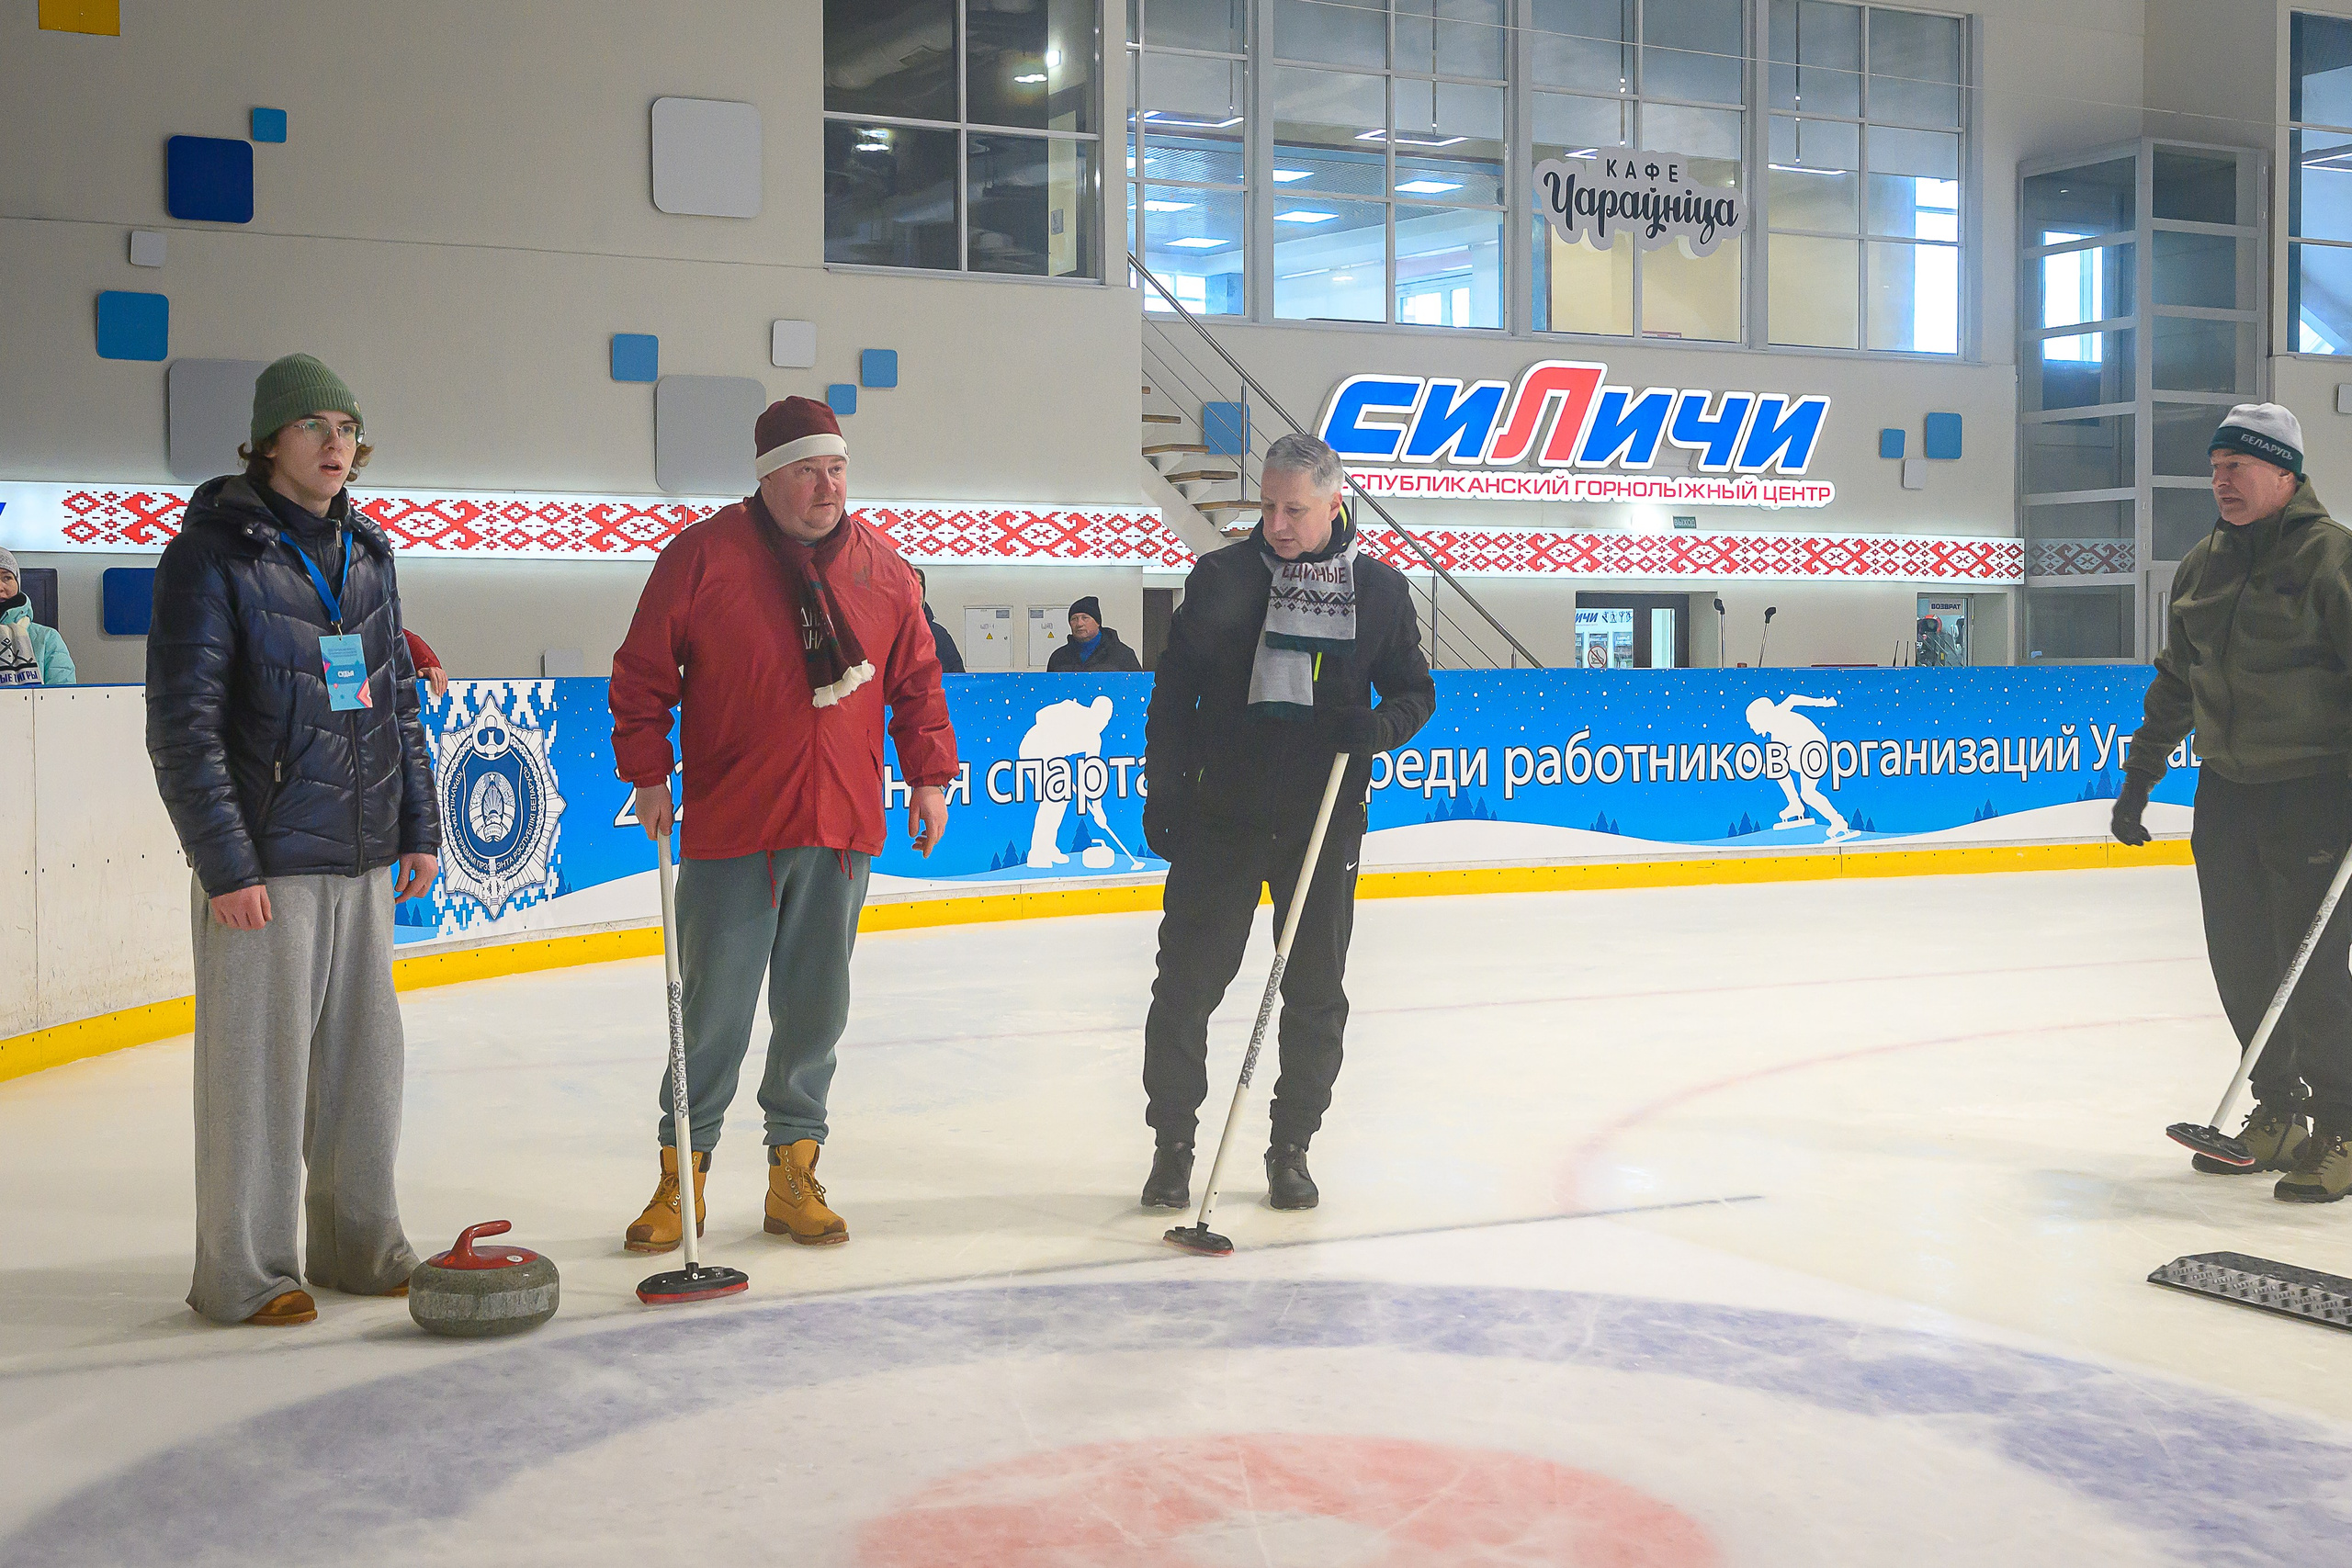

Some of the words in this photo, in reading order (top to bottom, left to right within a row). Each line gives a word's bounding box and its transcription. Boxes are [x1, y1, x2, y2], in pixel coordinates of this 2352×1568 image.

[1606, 158, 1679, 183] КАФЕ
[1543, 171, 1739, 245] Чараўніца
[2240, 434, 2293, 460] БЕЛАРУСЬ
[1343, 473, 1569, 496] СПУБЛИКАНСКИЙ
[1575, 478, 1758, 502] ГОРНОЛЫЖНЫЙ
[1763, 485, 1831, 506] ЦЕНТР
[1282, 563, 1348, 584] ЕДИНЫЕ
[1575, 612, 1599, 624] ИЧИ
[0, 673, 13, 683] ЫЕ
[1365, 744, 1488, 805] реди
[1504, 728, 1791, 800] работников
[1800, 723, 2081, 791] организаций
[523, 766, 537, 811] БЕЛАРУСЬ
